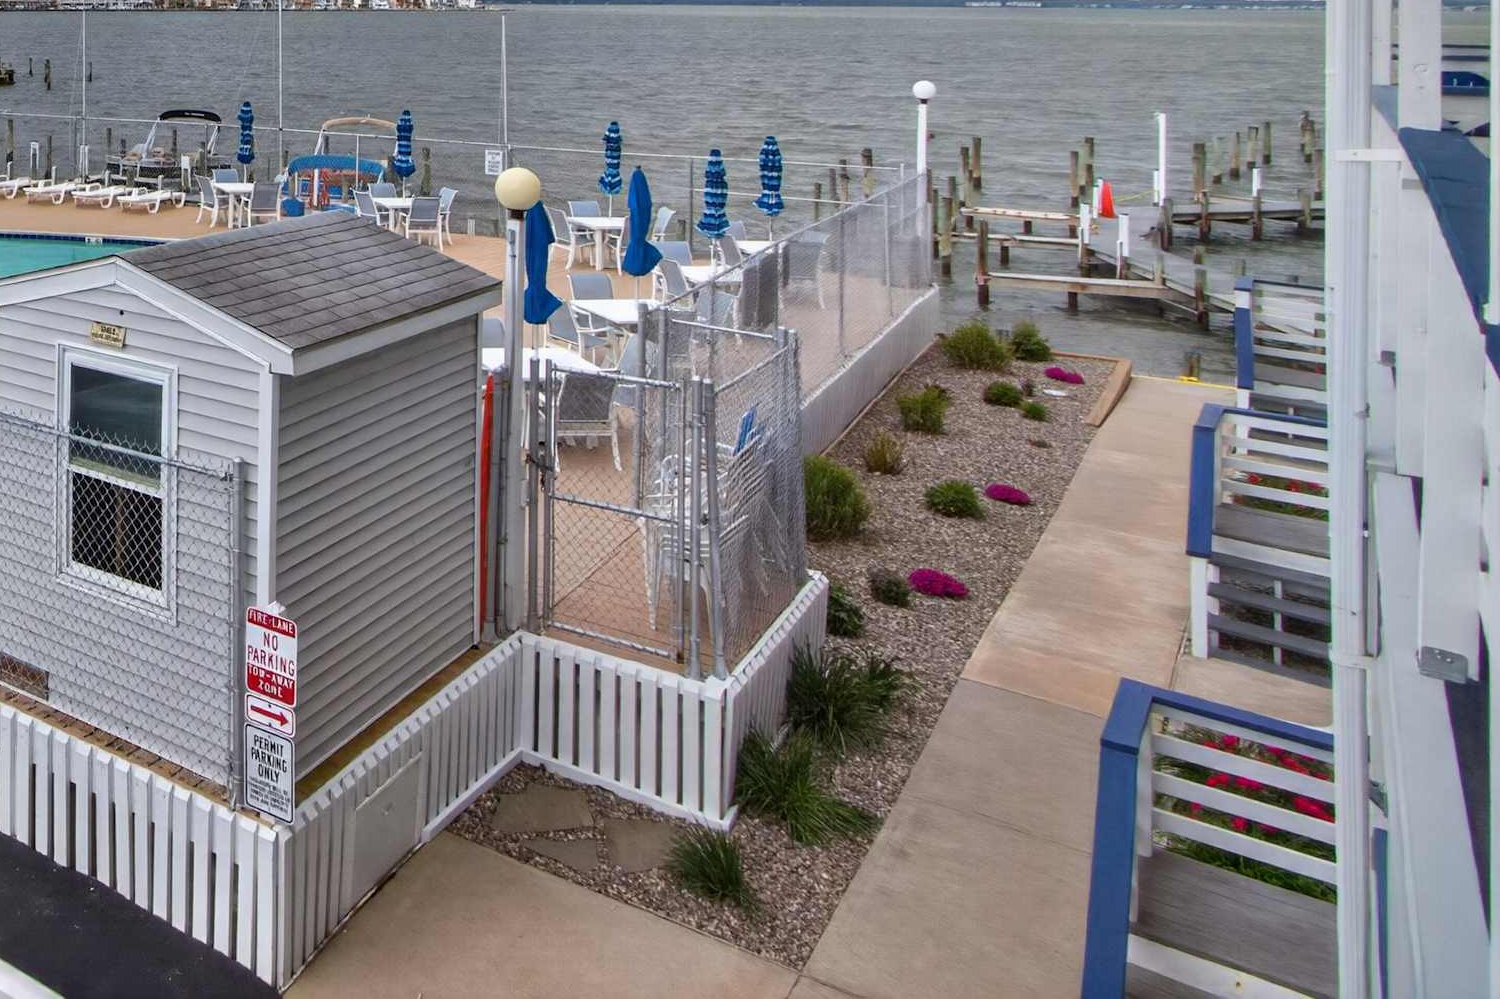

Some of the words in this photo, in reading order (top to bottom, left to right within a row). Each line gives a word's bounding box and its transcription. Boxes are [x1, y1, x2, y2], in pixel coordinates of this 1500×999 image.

[249, 608, 268, 625] FIRE
[272, 617, 294, 634] LANE
[263, 631, 278, 652] NO
[247, 645, 295, 677] PARKING
[248, 664, 294, 689] TOW-AWAY
[258, 678, 283, 698] ZONE
[253, 734, 284, 758] PERMIT
[251, 746, 288, 773] PARKING
[258, 763, 280, 784] ONLY
